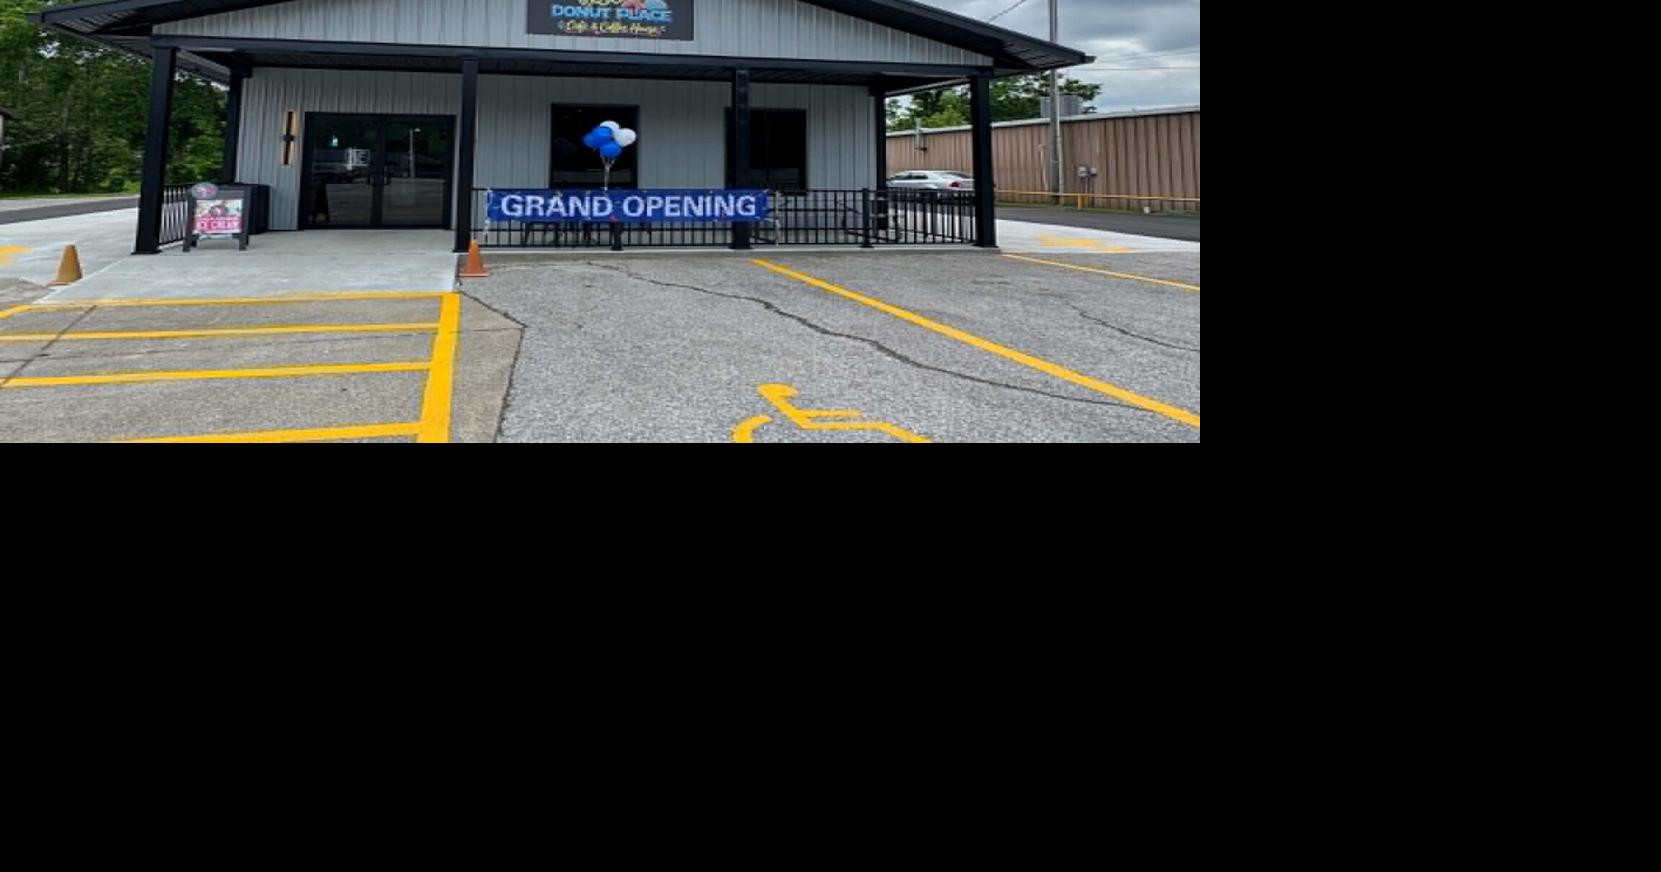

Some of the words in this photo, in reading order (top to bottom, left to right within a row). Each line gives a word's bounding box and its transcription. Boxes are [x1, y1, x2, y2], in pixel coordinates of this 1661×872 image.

[551, 5, 610, 17] DONUT
[616, 8, 672, 22] PLACE
[501, 195, 612, 217] GRAND
[622, 195, 756, 217] OPENING
